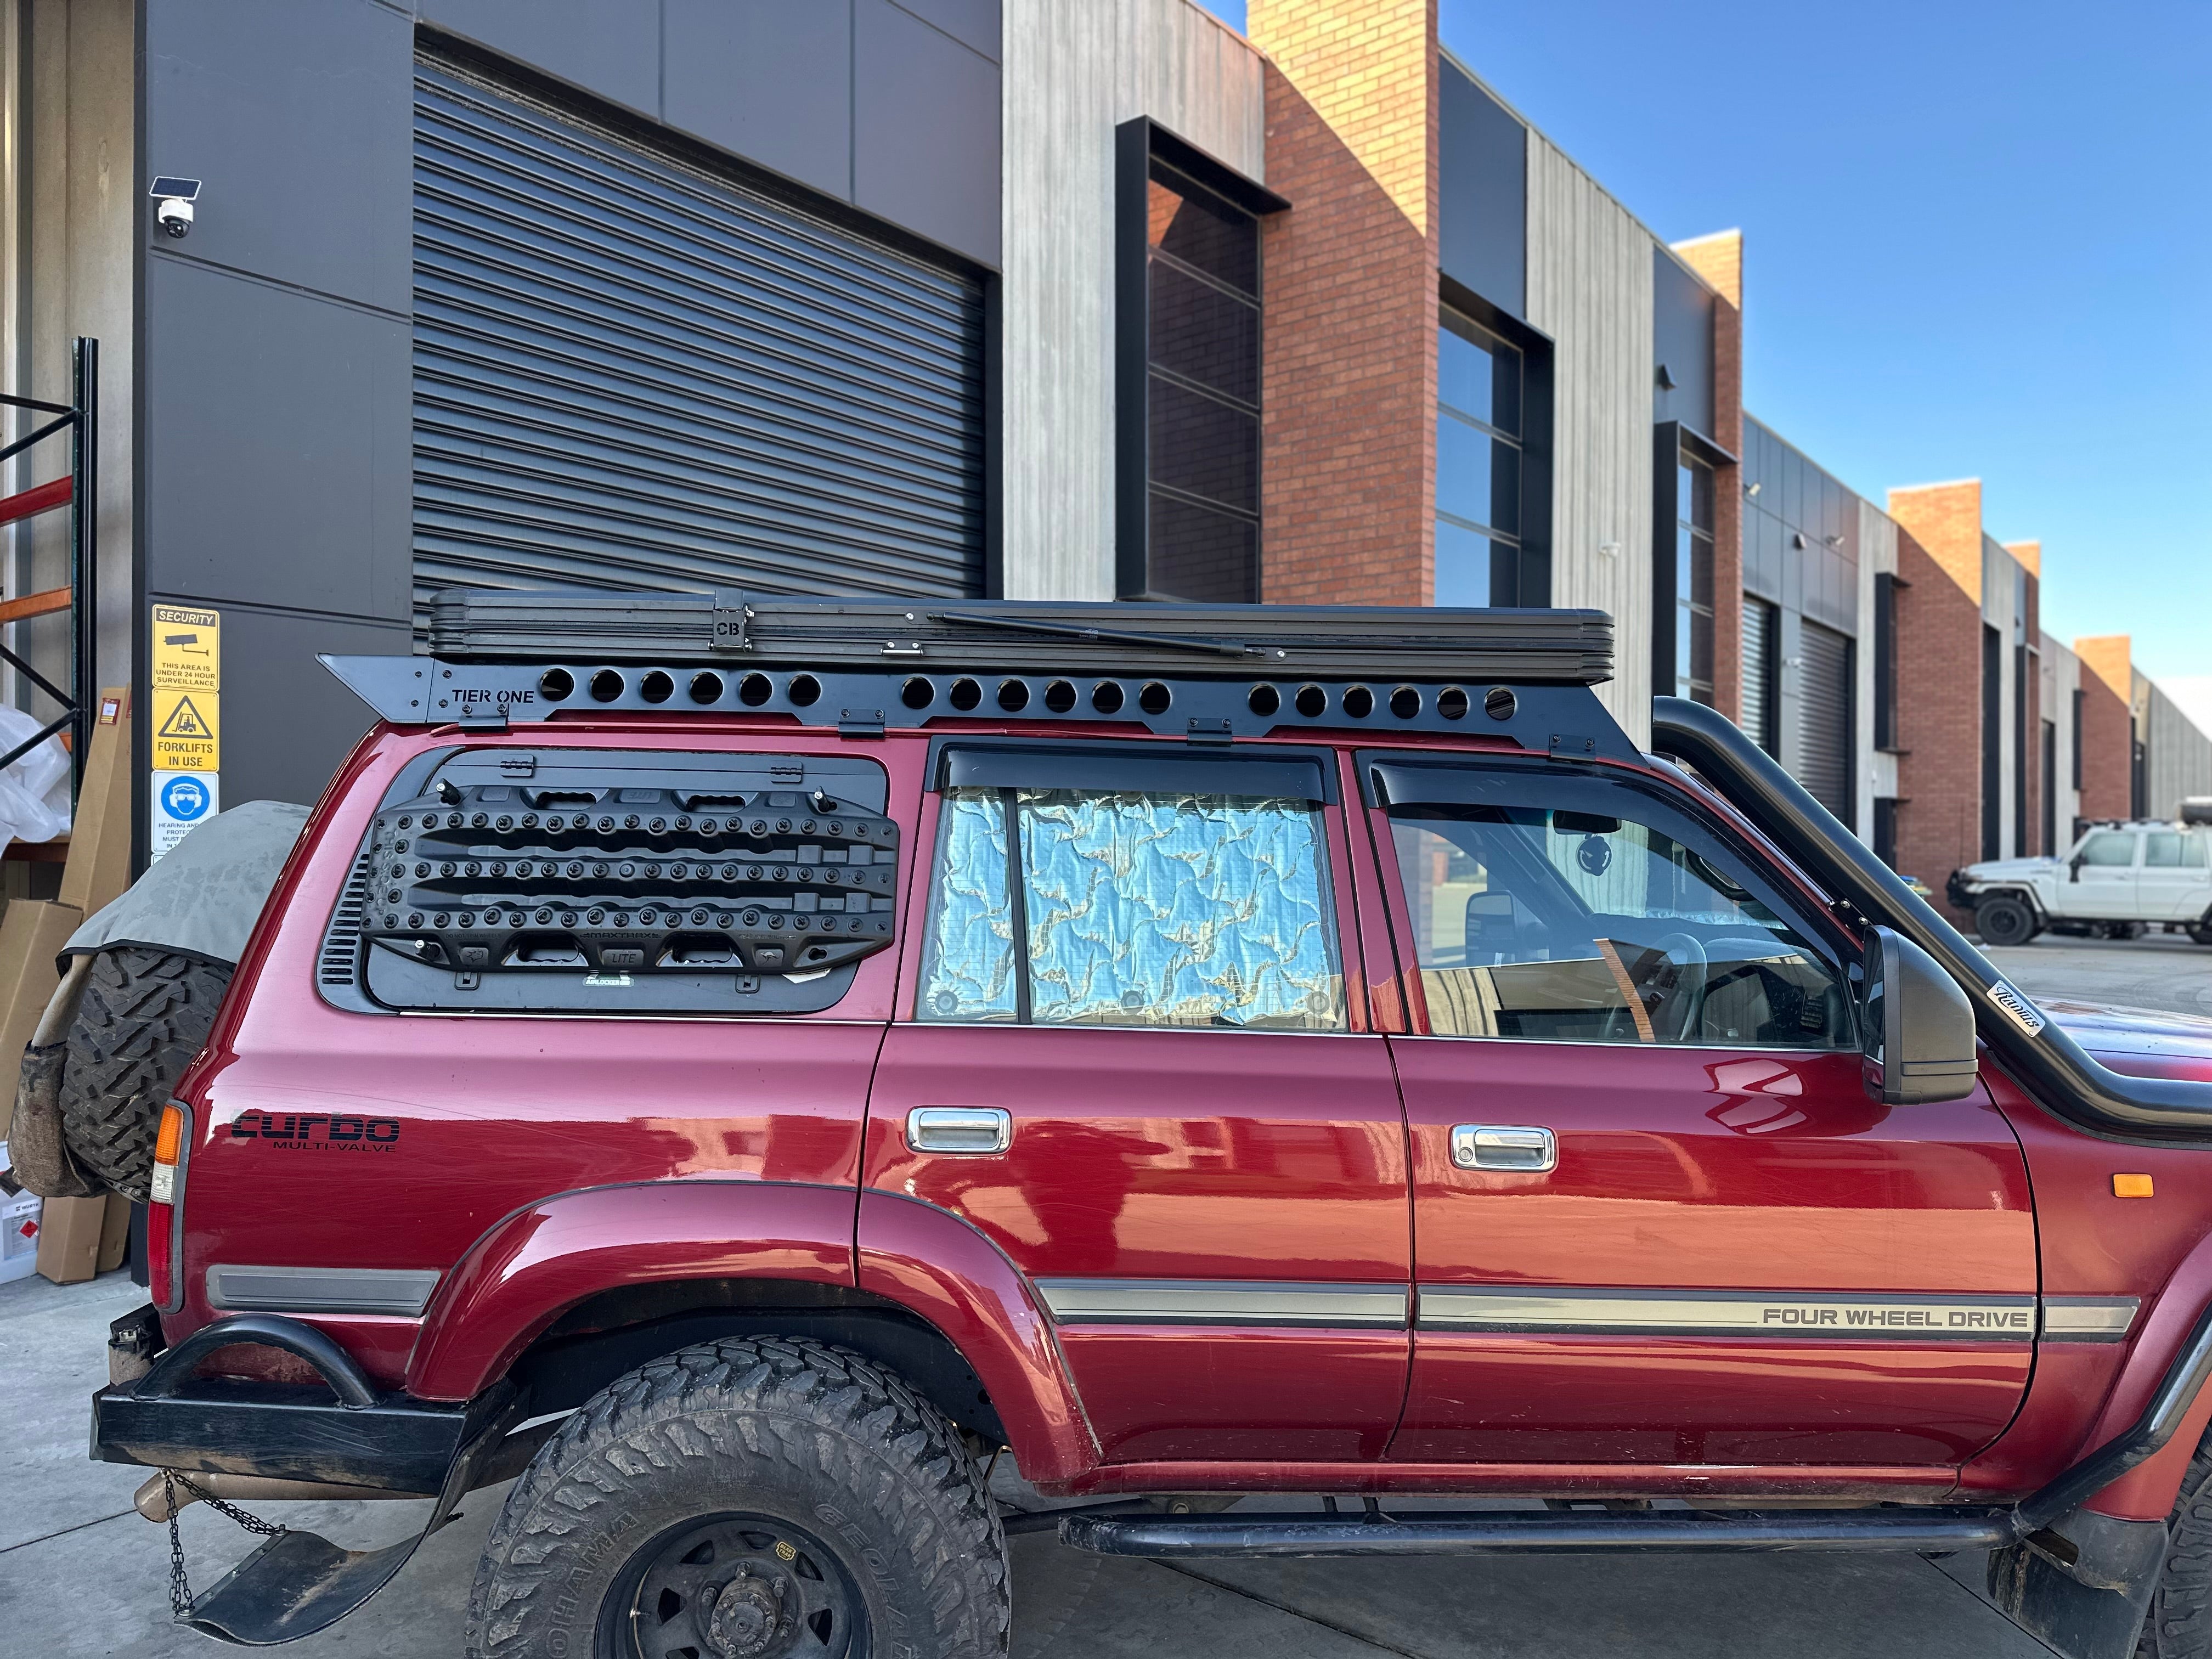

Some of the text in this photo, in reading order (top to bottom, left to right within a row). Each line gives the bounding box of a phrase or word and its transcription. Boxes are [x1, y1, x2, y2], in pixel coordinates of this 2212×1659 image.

[159, 610, 213, 625] SECURITY
[716, 622, 740, 636] CB
[157, 676, 215, 686] SURVEILLANCE
[452, 689, 535, 703] TIER ONE
[158, 742, 213, 753] FORKLIFTS
[169, 756, 202, 767] IN USE
[612, 953, 637, 963] LITE
[274, 1141, 397, 1153] MULTI-VALVE
[1763, 1308, 2028, 1328] FOUR WHEEL DRIVE
[780, 1544, 793, 1553] BLAK
[780, 1549, 792, 1558] TRAK
